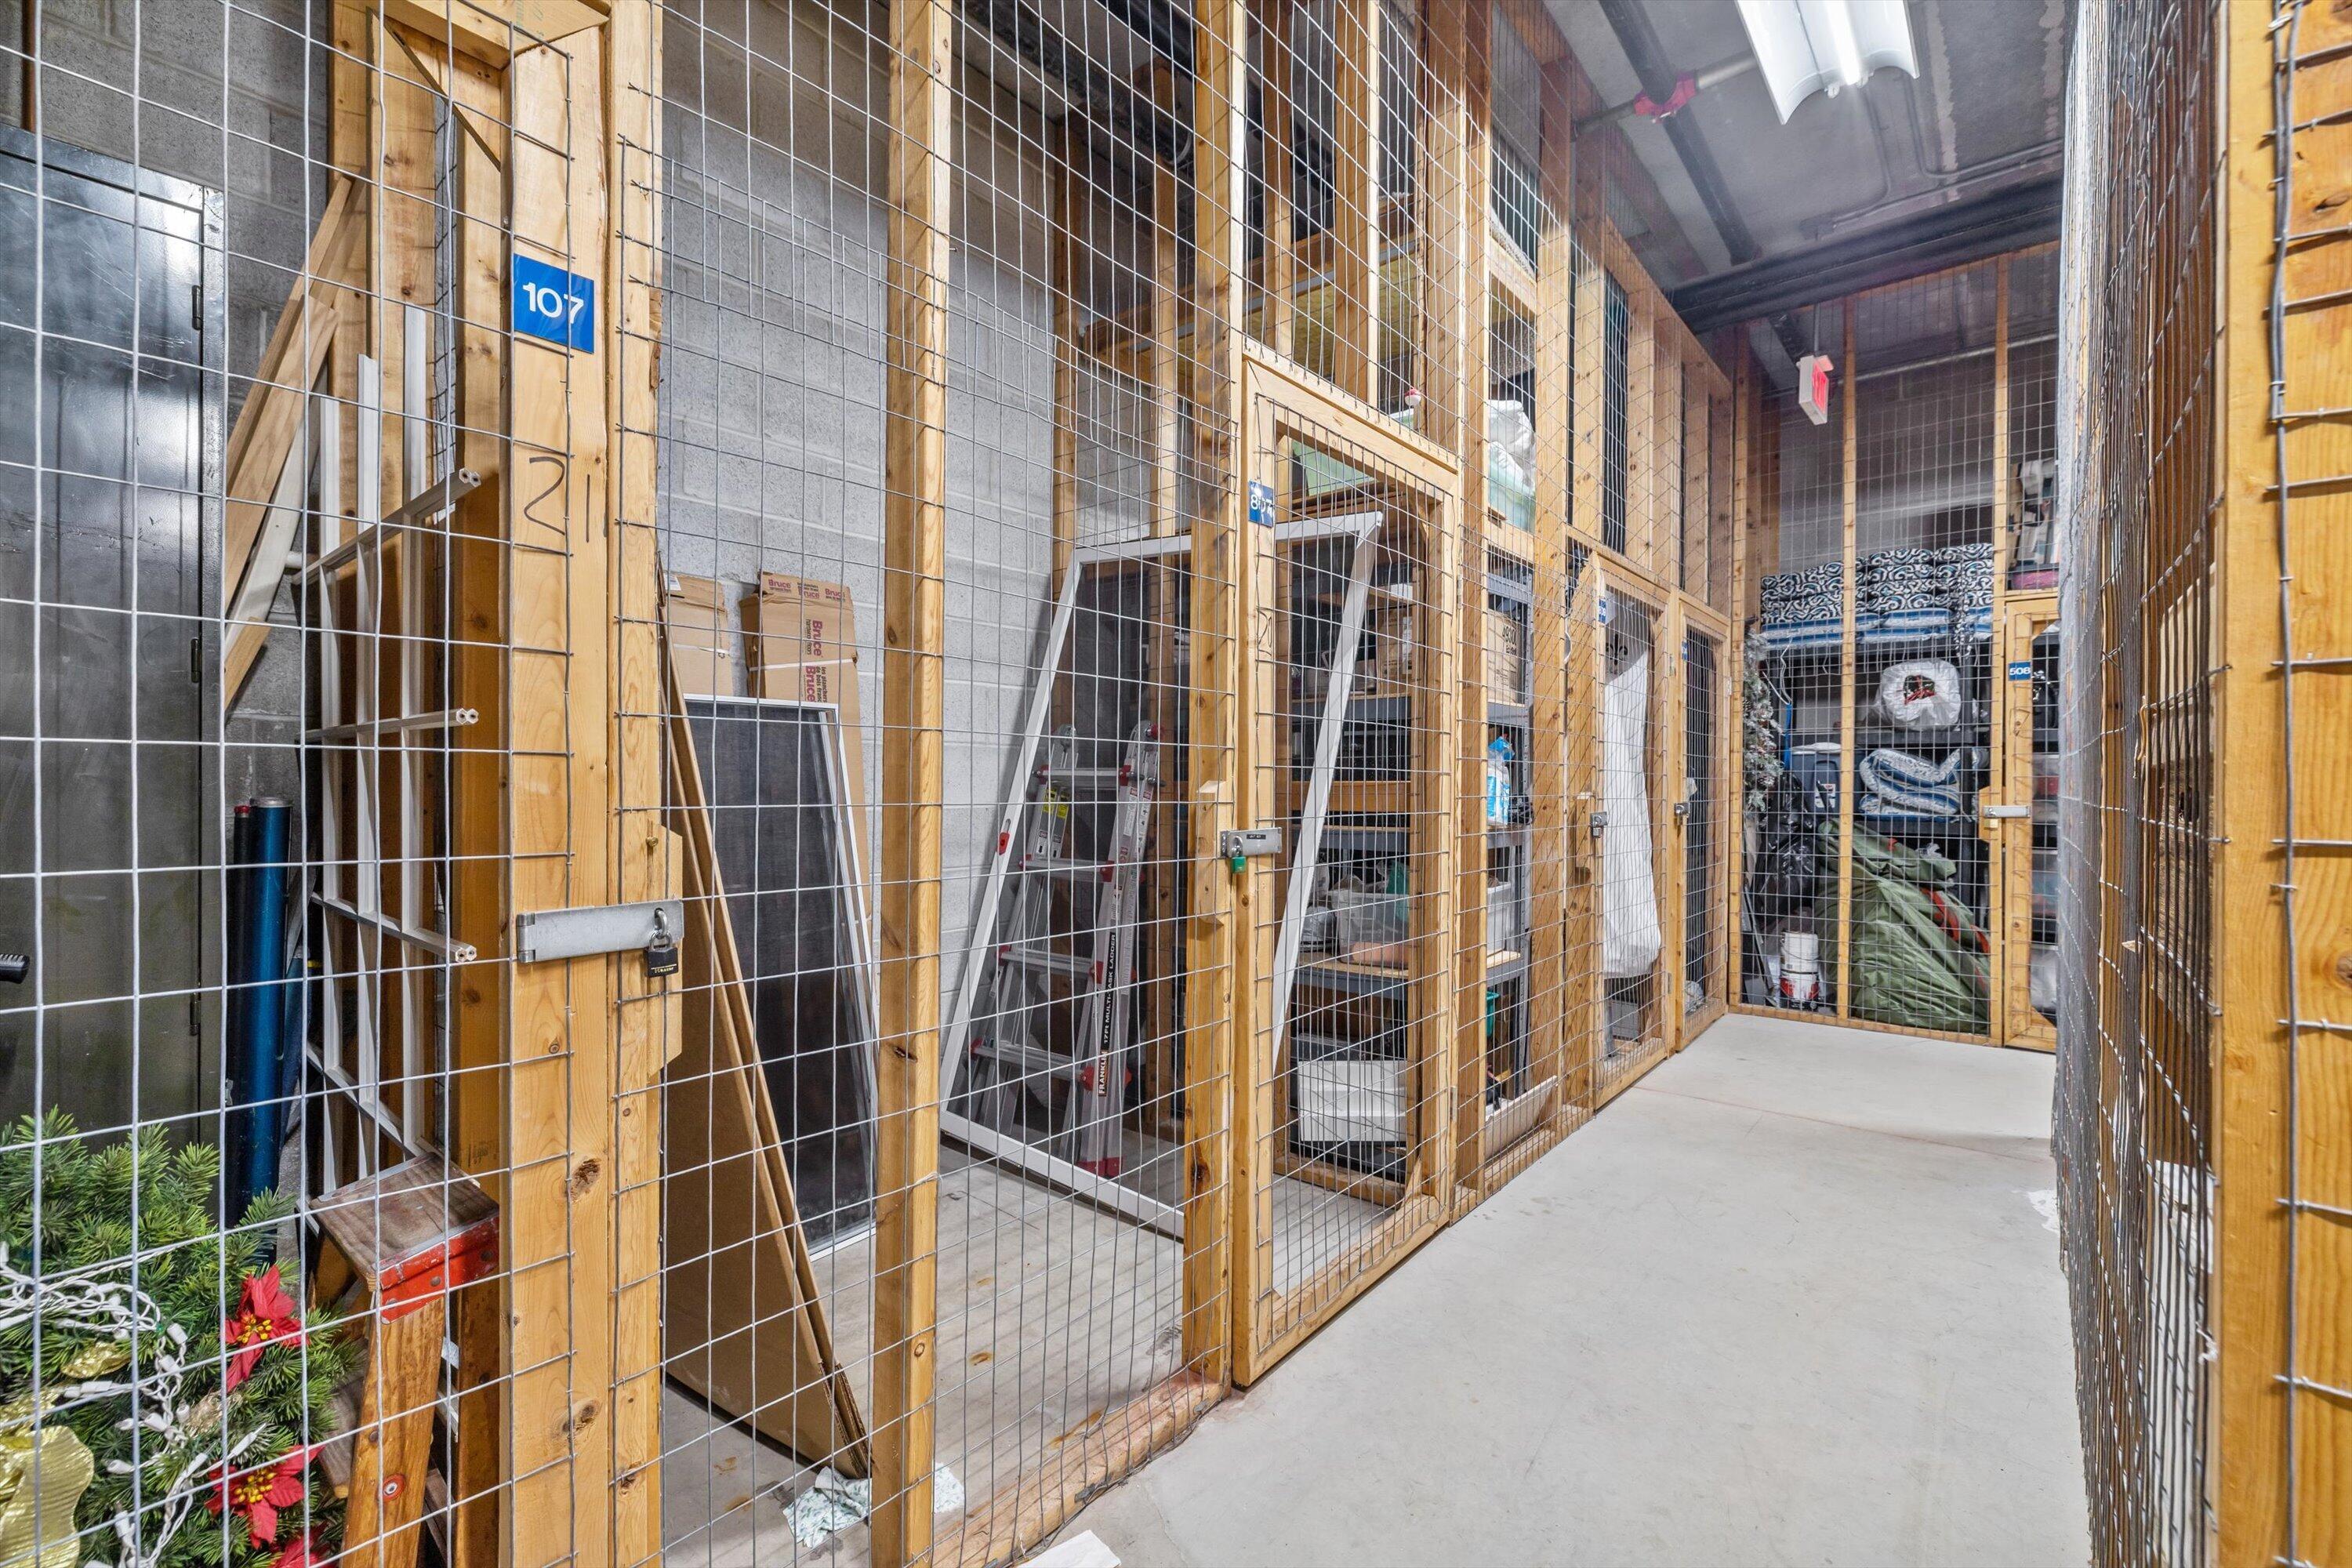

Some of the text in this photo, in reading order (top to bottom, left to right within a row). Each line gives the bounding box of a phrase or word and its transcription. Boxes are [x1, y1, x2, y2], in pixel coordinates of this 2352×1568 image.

[522, 281, 584, 325] 107
[523, 456, 590, 543] 21
[768, 579, 791, 589] Bruce
[812, 620, 823, 656] Bruce
[806, 666, 816, 702] Bruce
[2009, 666, 2031, 676] 508
